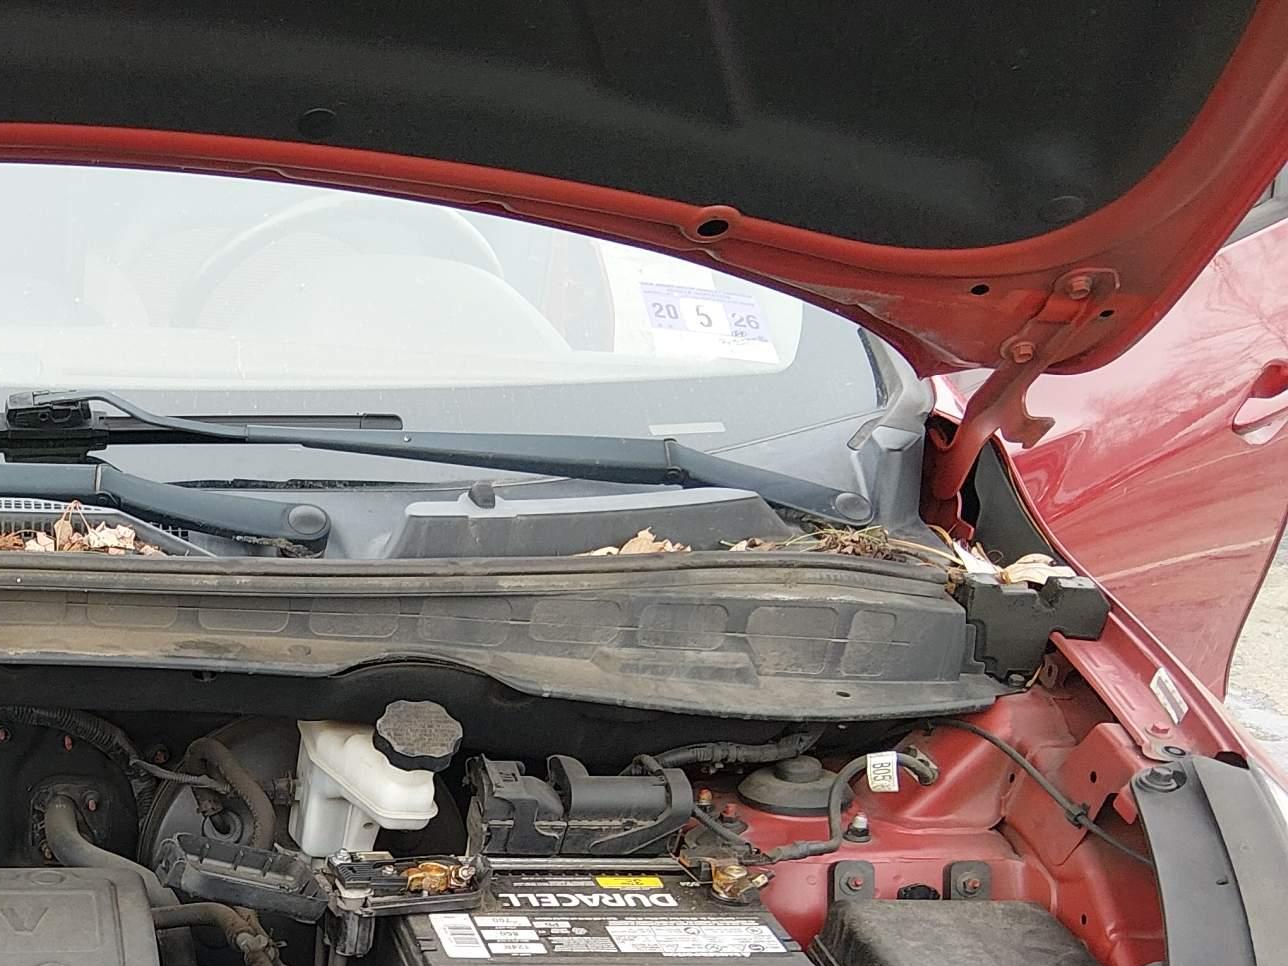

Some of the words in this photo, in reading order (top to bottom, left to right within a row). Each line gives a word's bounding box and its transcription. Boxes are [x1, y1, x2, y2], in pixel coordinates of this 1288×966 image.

[651, 302, 680, 320] 20
[695, 304, 713, 328] 5
[731, 312, 760, 330] 26
[499, 893, 679, 907] DURACELL
